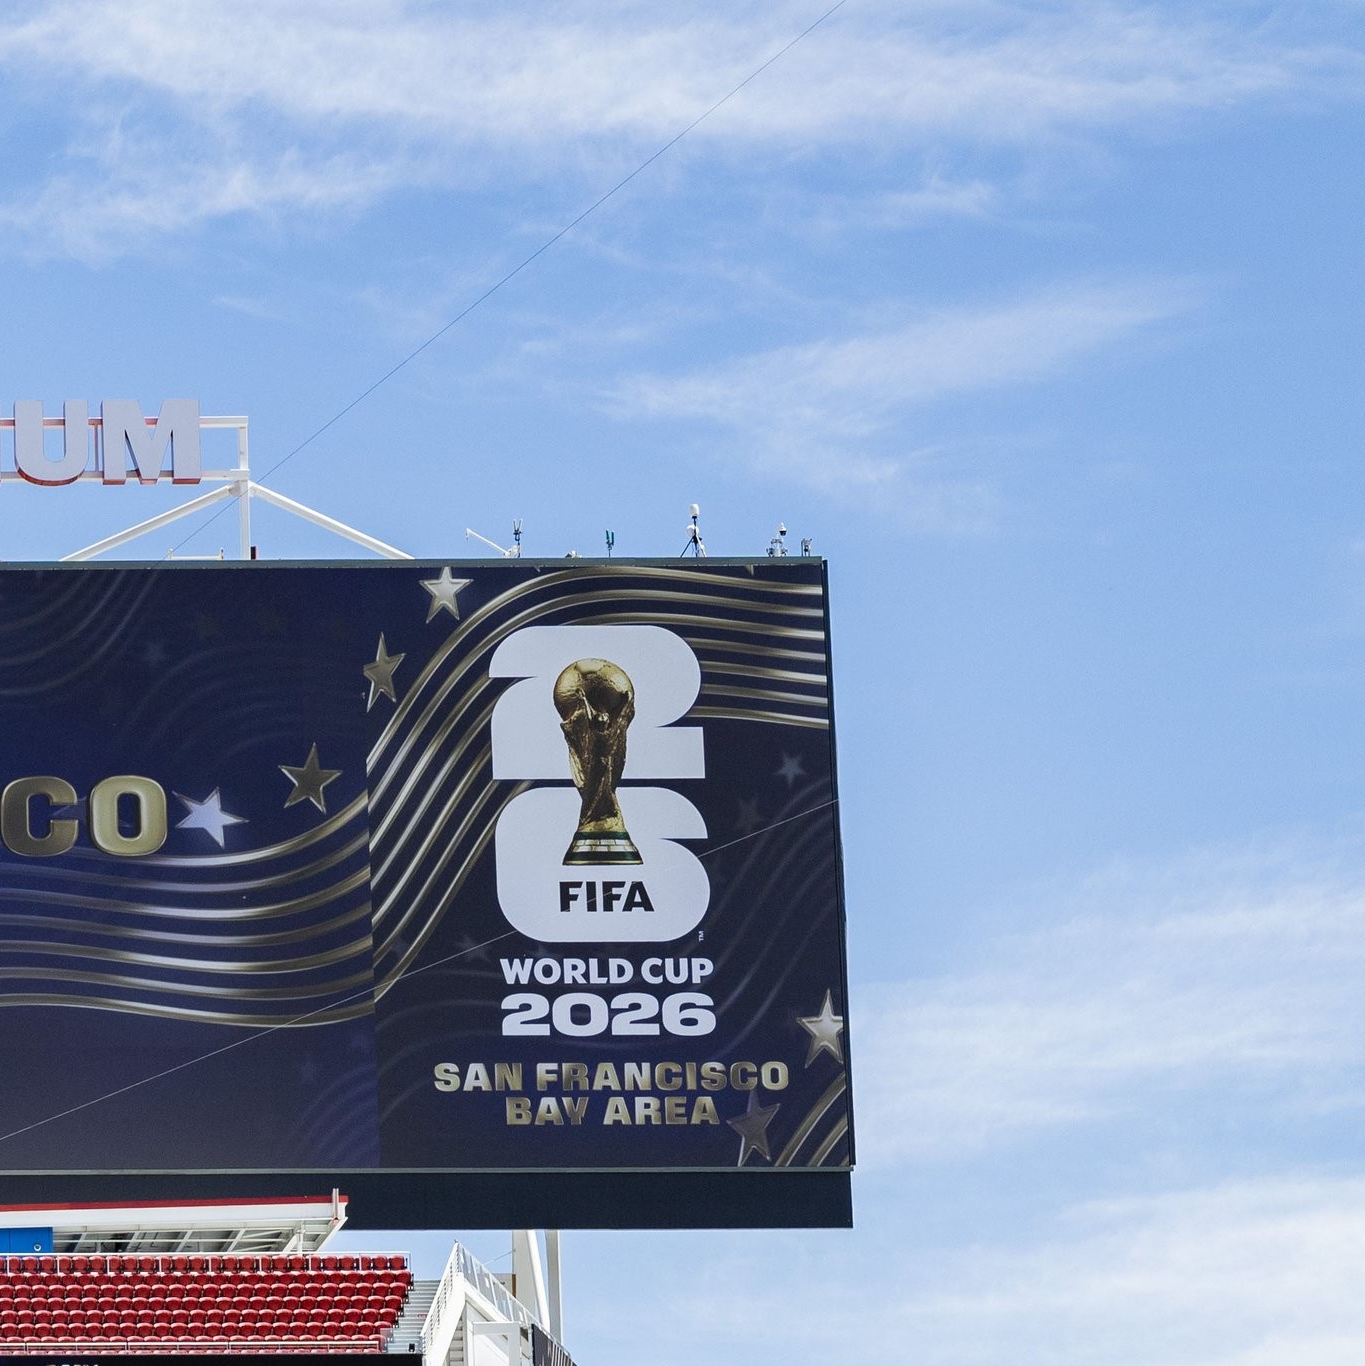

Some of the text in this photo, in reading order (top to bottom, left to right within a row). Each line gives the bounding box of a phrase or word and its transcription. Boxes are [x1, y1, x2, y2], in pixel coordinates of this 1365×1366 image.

[559, 881, 654, 912] FIFA
[500, 957, 714, 984] WORLD CUP
[501, 993, 716, 1036] 2026
[433, 1061, 789, 1092] SAN FRANCISCO
[505, 1095, 720, 1126] BAY AREA
